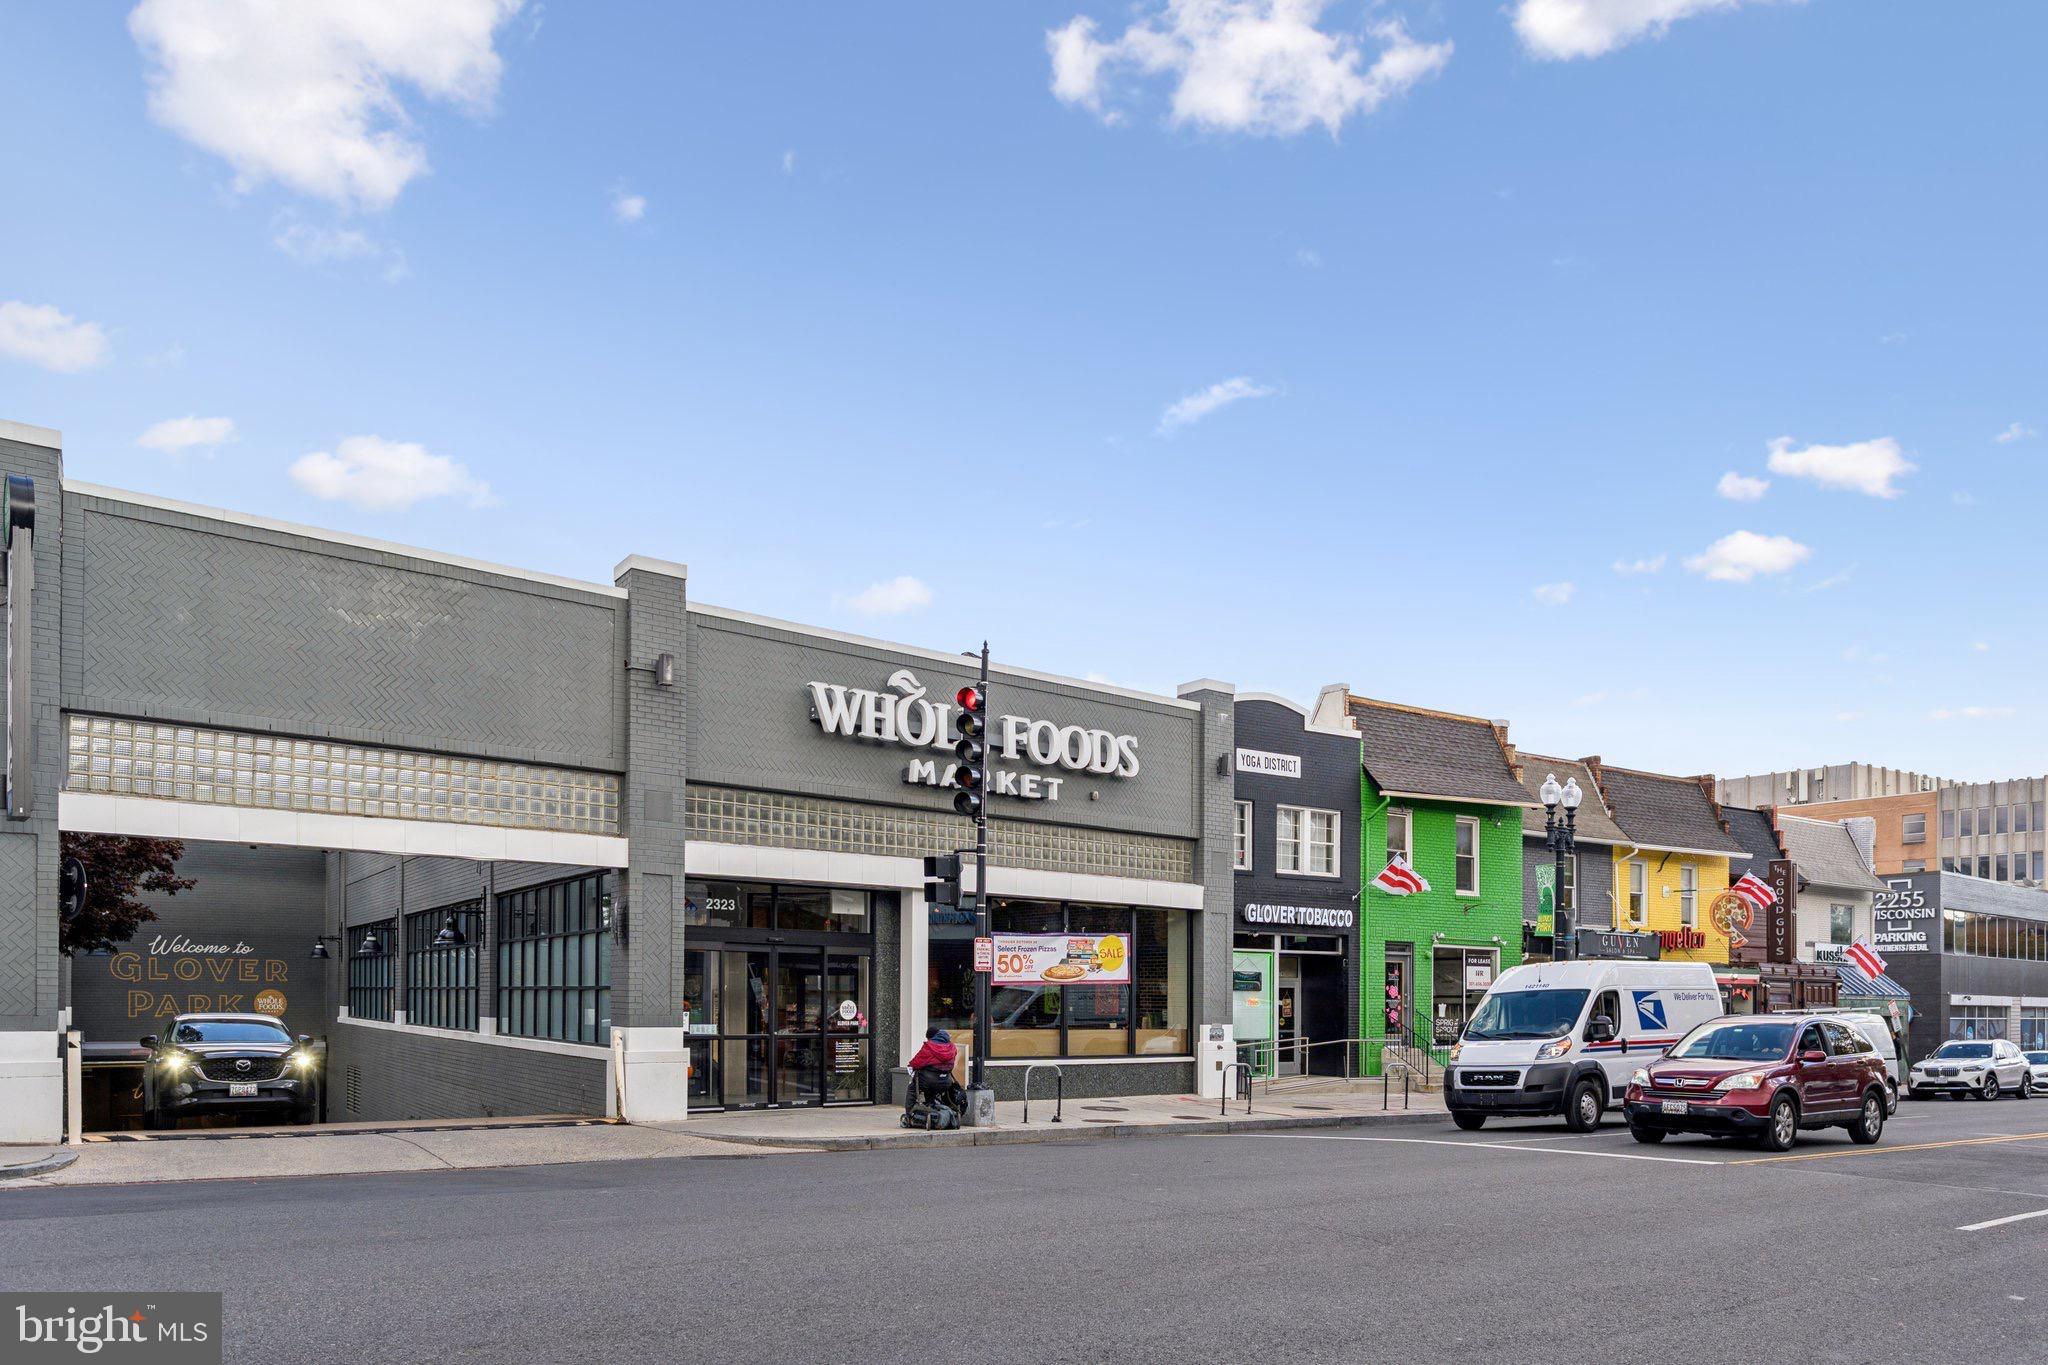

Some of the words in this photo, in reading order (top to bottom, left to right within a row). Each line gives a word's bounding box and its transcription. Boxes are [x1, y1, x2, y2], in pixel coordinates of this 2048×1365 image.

[807, 671, 985, 752] WHOL
[1000, 714, 1140, 778] FOODS
[1241, 754, 1261, 768] YOGA
[1264, 757, 1297, 772] DISTRICT
[908, 759, 1063, 800] MAKET
[1774, 865, 1786, 876] THE
[706, 898, 735, 910] 2323
[1776, 879, 1784, 914] GOOD
[1875, 891, 1925, 909] 2255
[1245, 904, 1296, 924] GLOVER
[1297, 906, 1353, 927] TOBACCO
[1875, 908, 1935, 920] ISCONSIN
[149, 935, 230, 955] Welcome
[233, 941, 254, 955] to
[1602, 935, 1639, 948] GUVEN
[1656, 926, 1705, 952] ngelico
[1776, 918, 1784, 956] GUYS
[1875, 932, 1926, 942] PARKING
[997, 953, 1034, 973] 50%
[1100, 948, 1123, 958] SALE
[110, 952, 288, 983] GLOVER
[128, 990, 244, 1017] PARK
[1673, 992, 1681, 1000] We
